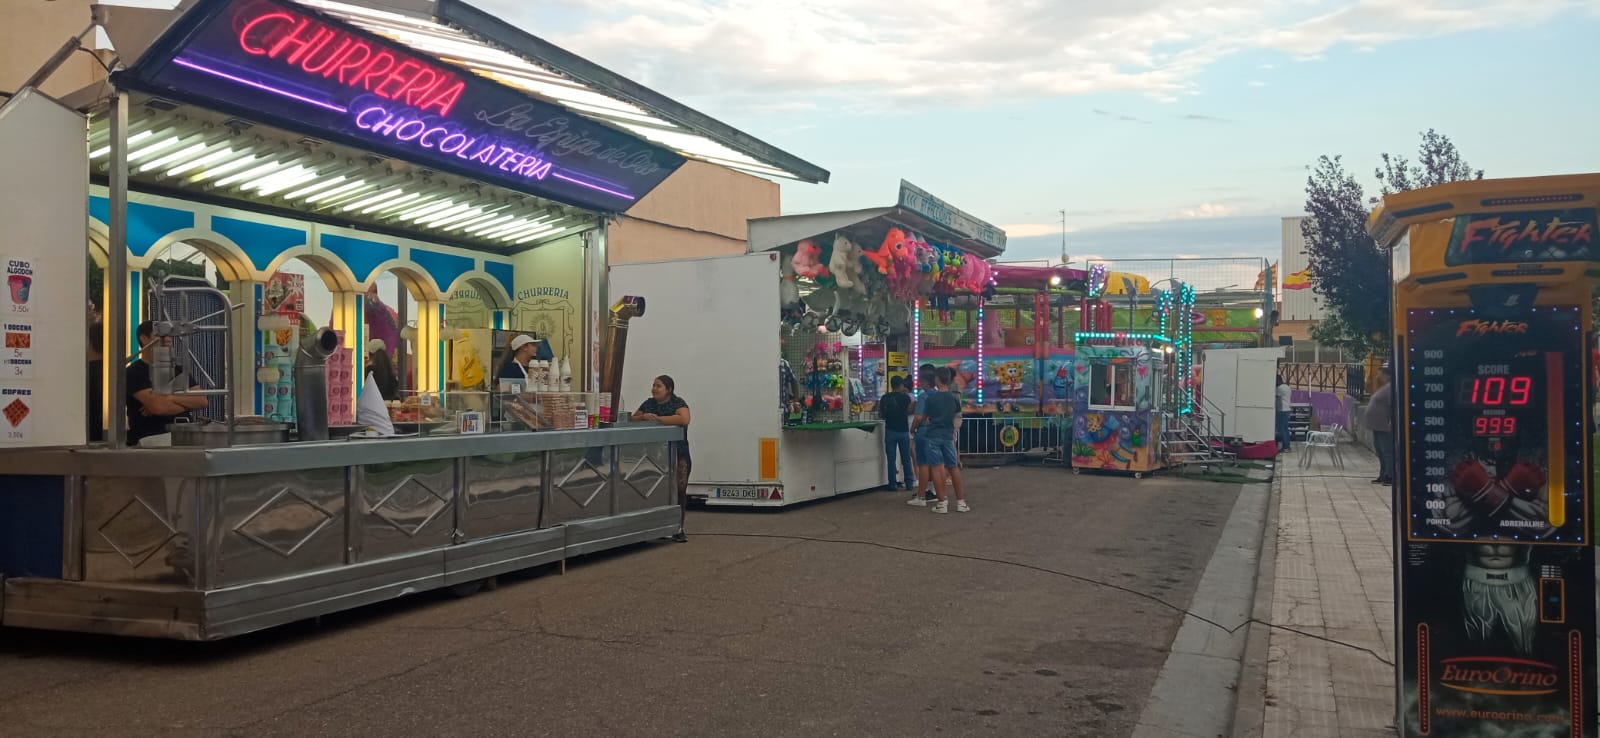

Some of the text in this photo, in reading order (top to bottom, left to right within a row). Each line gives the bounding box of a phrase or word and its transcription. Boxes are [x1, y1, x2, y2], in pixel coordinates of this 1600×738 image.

[240, 11, 466, 117] CHURRERIA
[356, 106, 552, 180] CHOCOLATERIA
[9, 260, 30, 268] CUBO
[517, 287, 569, 300] CHURRERIA
[1424, 350, 1443, 359] 900
[1424, 367, 1443, 375] 800
[1478, 365, 1509, 374] SCORE
[1424, 383, 1444, 392] 700
[1471, 377, 1532, 405] 109
[1424, 400, 1444, 409] 600
[1424, 417, 1444, 426] 500
[1475, 417, 1516, 435] 999
[1425, 433, 1445, 442] 400
[1425, 450, 1445, 459] 300
[1425, 467, 1445, 476] 200
[1426, 484, 1445, 493] 100
[1426, 500, 1445, 510] 000
[1500, 520, 1544, 528] ADRENALINE
[1440, 665, 1557, 686] EuroOrino
